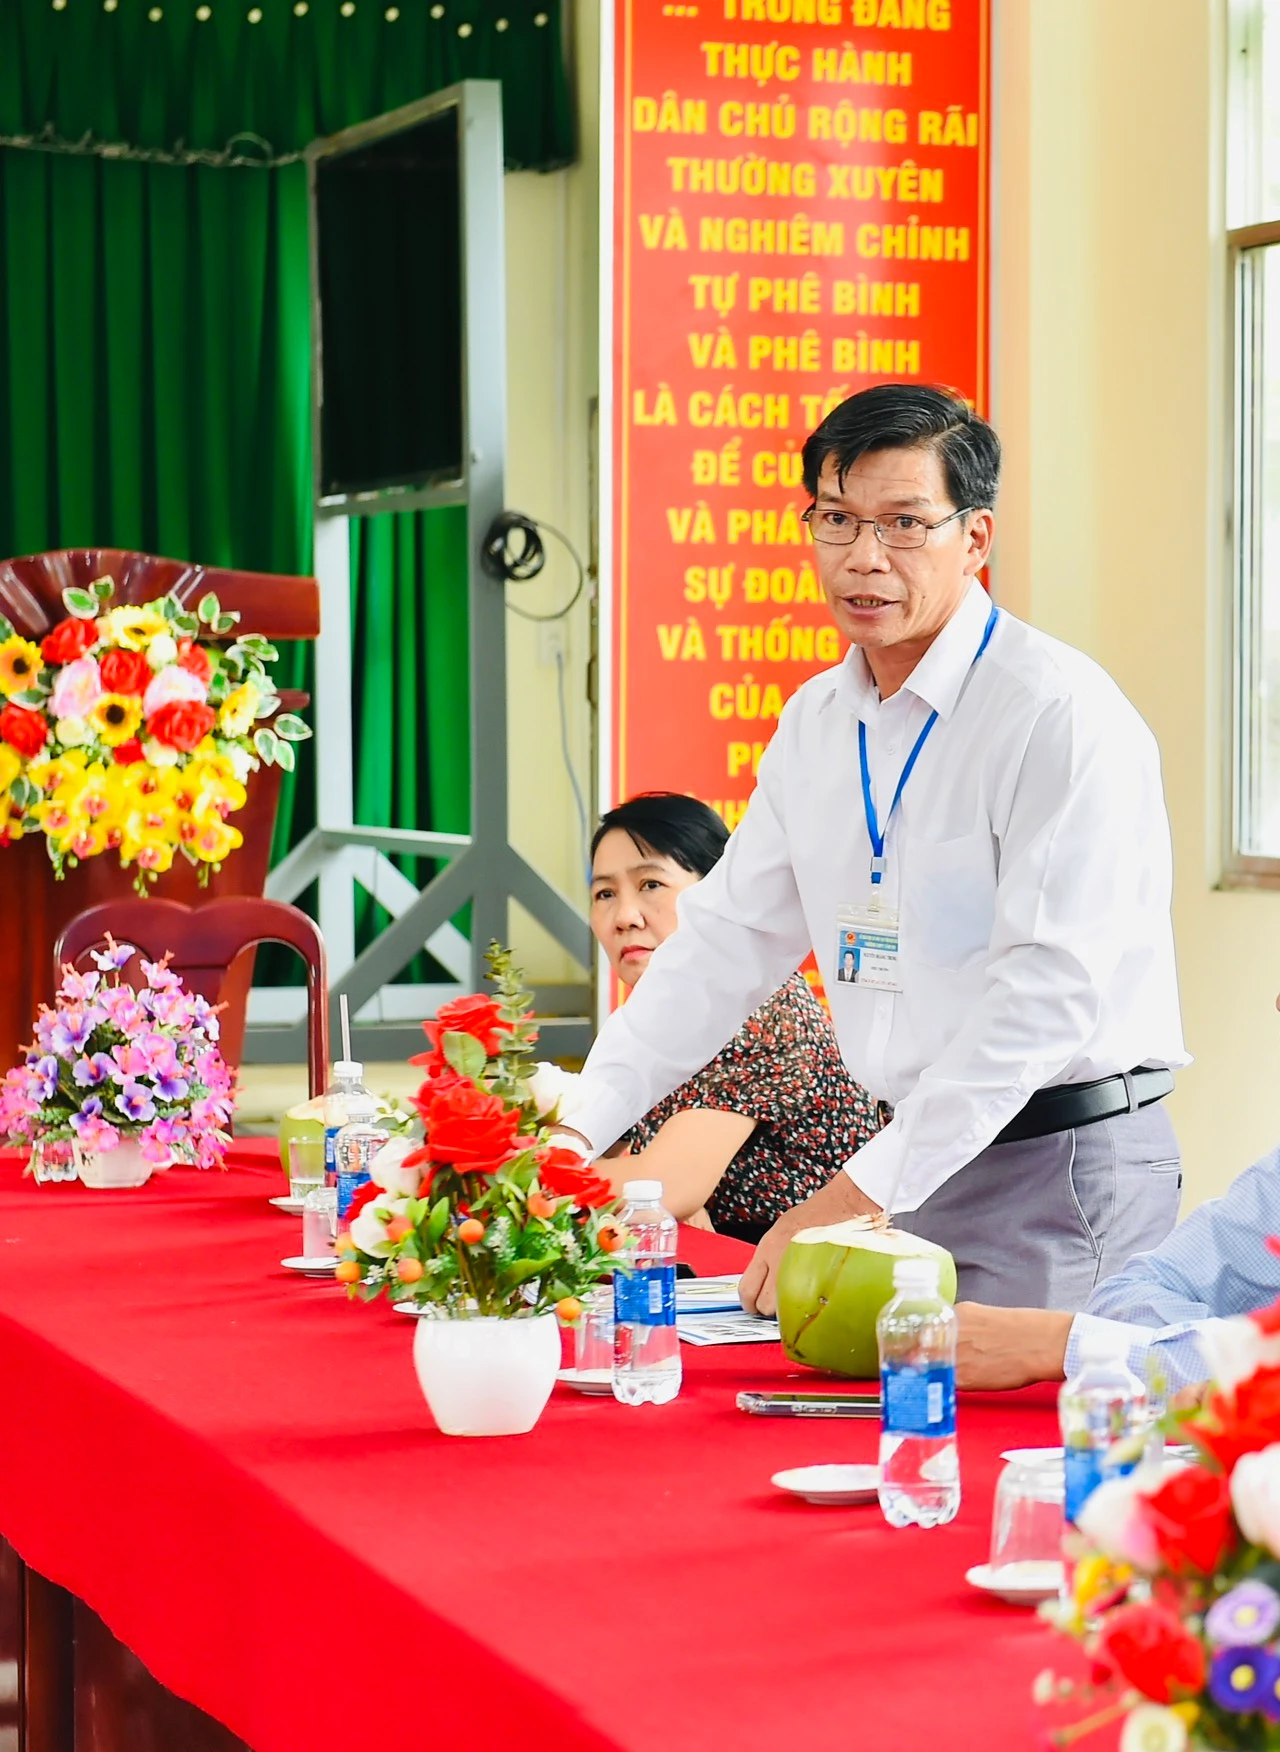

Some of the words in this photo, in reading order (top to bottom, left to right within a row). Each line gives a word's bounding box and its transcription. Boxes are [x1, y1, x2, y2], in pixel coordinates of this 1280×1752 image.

[702, 42, 801, 87] THỰC
[812, 42, 912, 86] HÀNH
[633, 90, 708, 134] DÂN
[718, 94, 796, 139] CHỦ
[808, 100, 908, 148] RỘNG
[918, 105, 979, 146] RÃI
[667, 153, 817, 197] THƯỜNG
[827, 160, 944, 203] XUYÊN
[639, 208, 689, 250] VÀ
[700, 213, 845, 256] NGHIÊM
[856, 215, 970, 261] CHỈNH
[688, 272, 740, 318] TỰ
[748, 272, 821, 314] PHÊ
[832, 273, 920, 317] BÌNH
[688, 326, 738, 369] VÀ
[749, 329, 821, 372] PHÊ
[833, 331, 920, 374] BÌNH
[633, 382, 678, 426] LÀ
[688, 384, 790, 429] CÁCH
[800, 384, 850, 430] TỐ
[692, 436, 742, 487] ĐỂ
[667, 501, 717, 544] VÀ
[684, 562, 735, 609] SỰ
[657, 617, 707, 661] VÀ
[716, 615, 840, 662] THỐNG
[709, 673, 785, 720] CỦA
